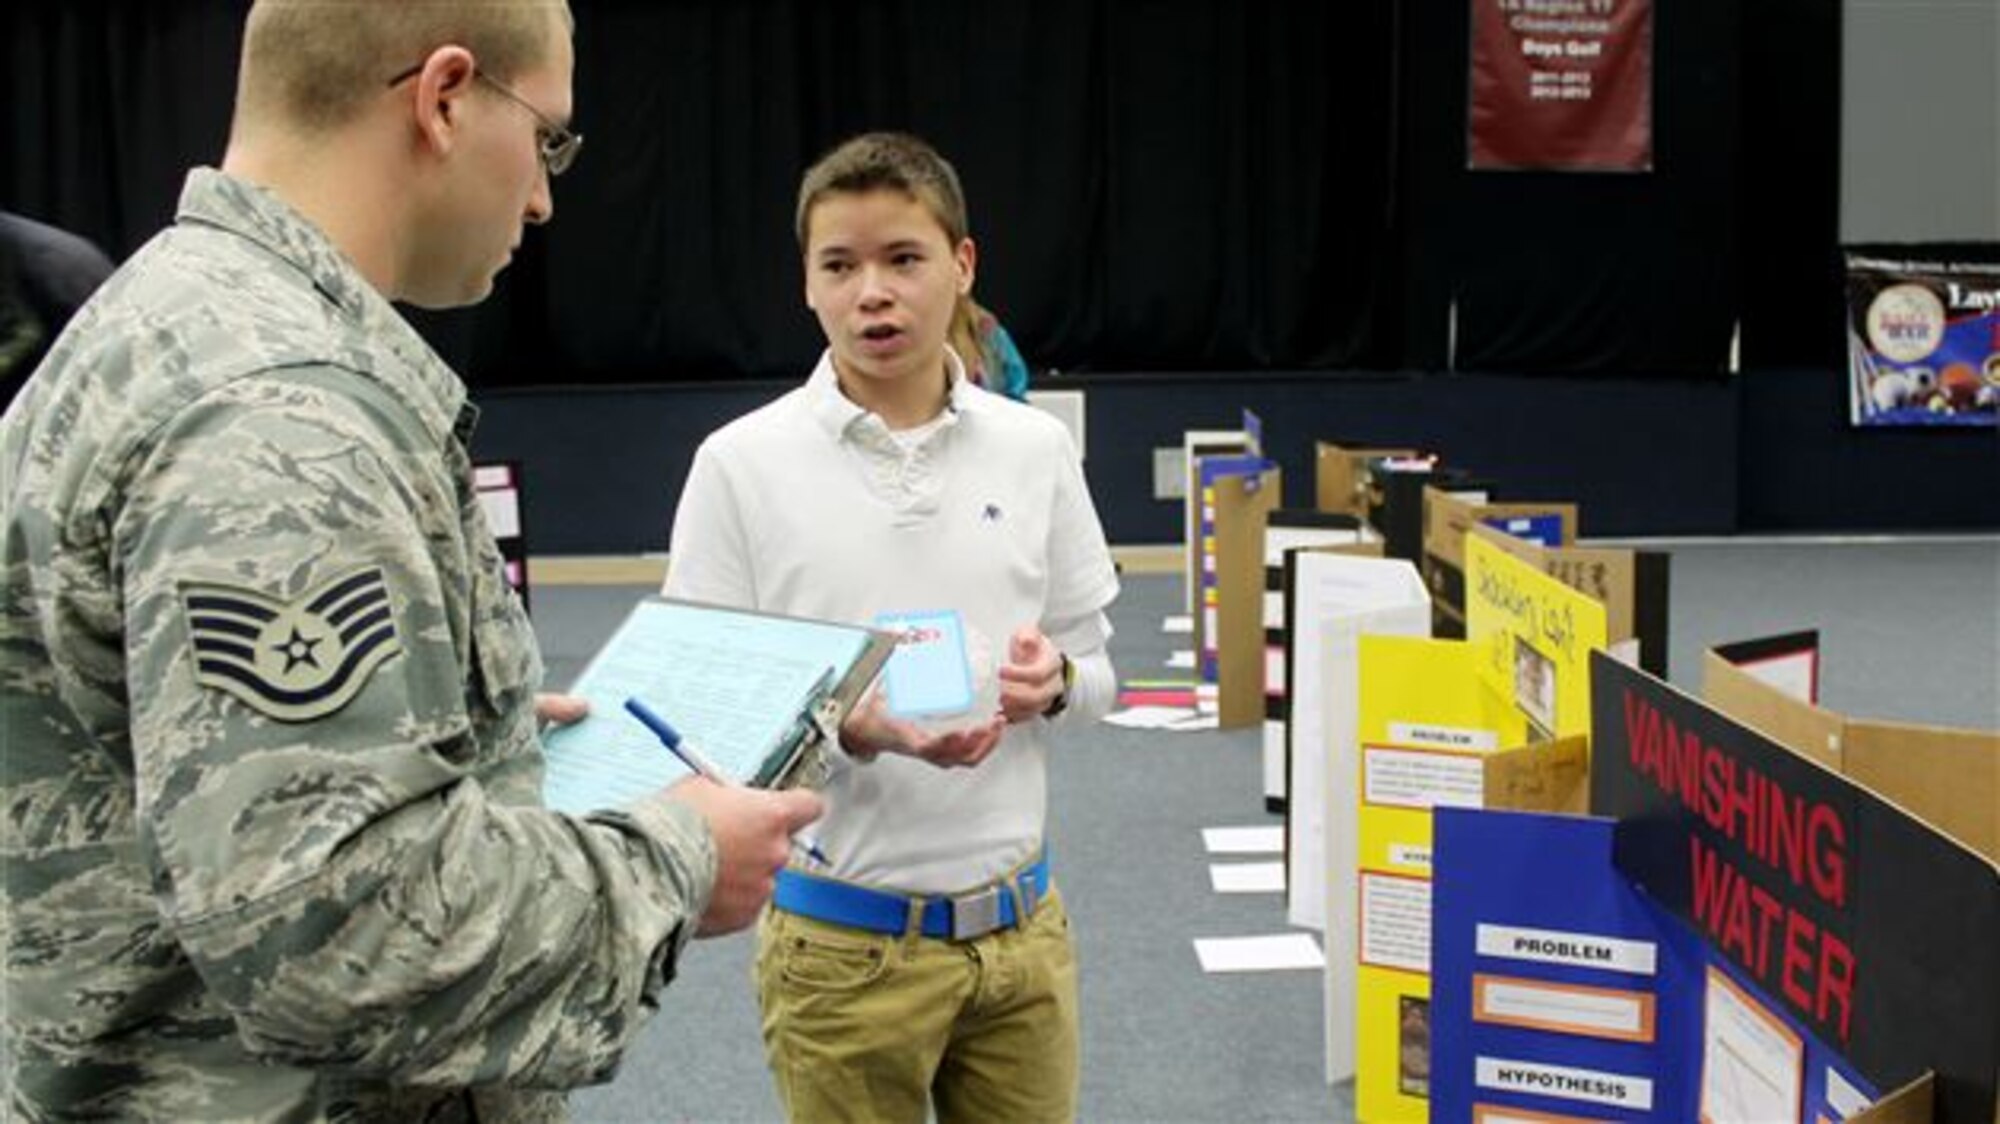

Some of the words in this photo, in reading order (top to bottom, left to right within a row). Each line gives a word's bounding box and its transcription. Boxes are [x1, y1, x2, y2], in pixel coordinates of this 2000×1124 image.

[1522, 39, 1562, 57] Boys
[1566, 40, 1601, 55] Golf
[1624, 689, 1845, 907] VANISHING
[1513, 936, 1613, 961] PROBLEM
[1690, 833, 1856, 1042] WATER
[1497, 1068, 1627, 1099] HYPOTHESIS
